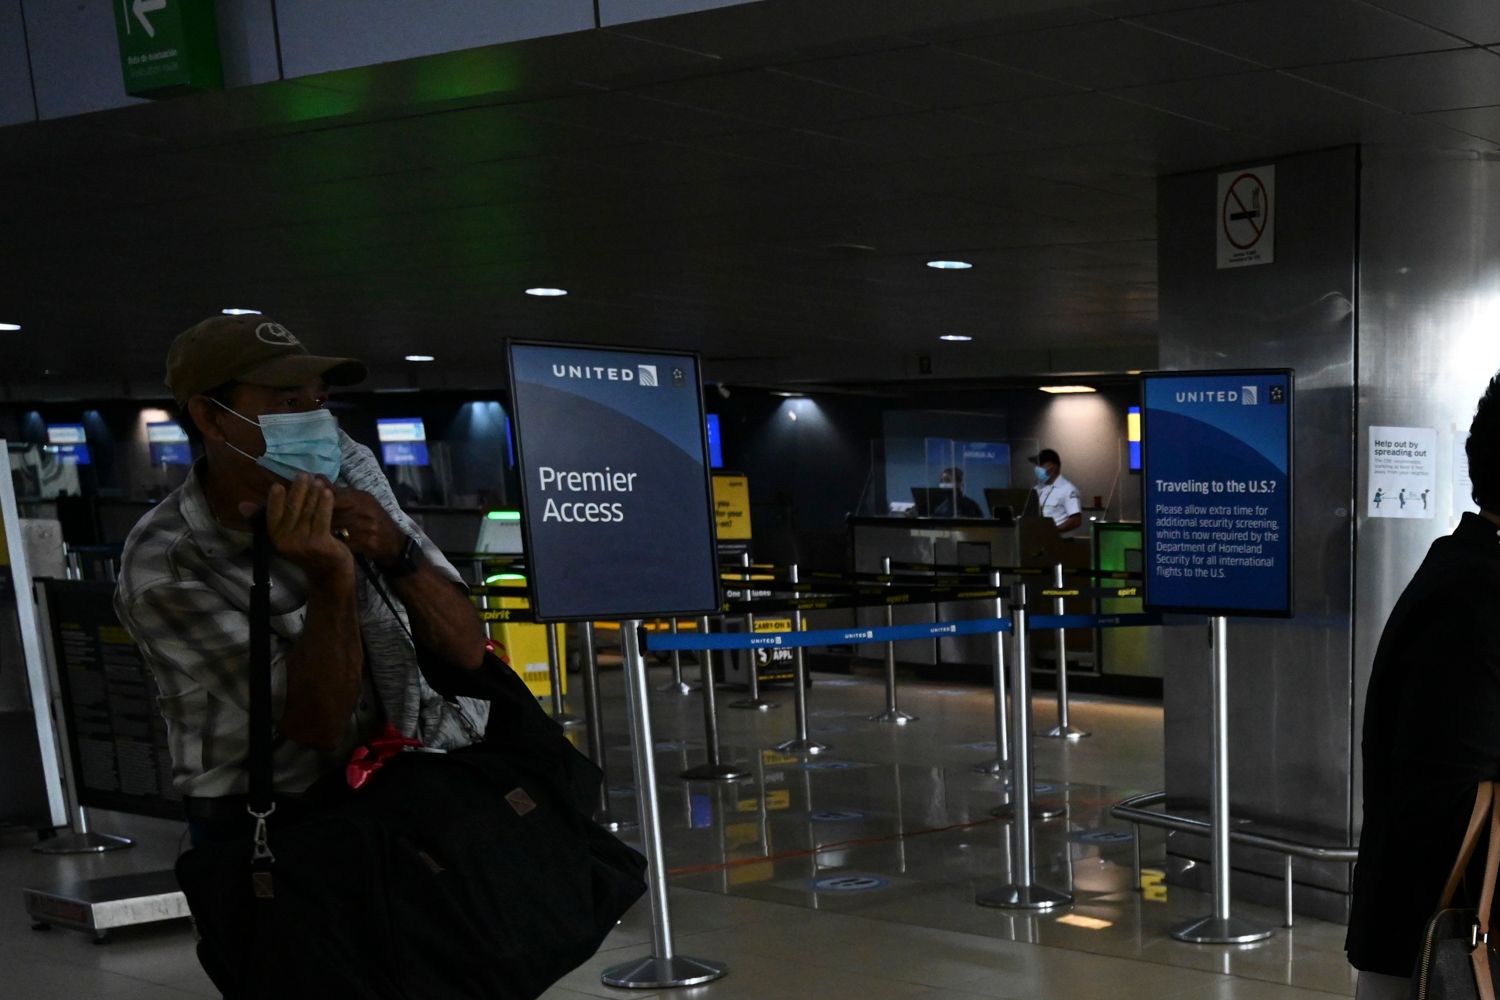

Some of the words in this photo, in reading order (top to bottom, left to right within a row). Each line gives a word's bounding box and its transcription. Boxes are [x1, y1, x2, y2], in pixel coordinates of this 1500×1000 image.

[553, 364, 634, 382] UNITED
[1176, 391, 1238, 403] UNITED
[1375, 440, 1392, 448] Help
[1409, 441, 1418, 450] by
[1374, 449, 1412, 457] spreading
[539, 467, 637, 492] Premier
[1156, 480, 1209, 494] Traveling
[1211, 481, 1224, 492] to
[1226, 480, 1246, 492] the
[1249, 480, 1276, 493] U.S.?
[543, 498, 624, 522] Access
[1156, 504, 1182, 514] Please
[1184, 505, 1207, 515] allow
[1209, 506, 1231, 515] extra
[1233, 505, 1253, 515] time
[1255, 506, 1268, 516] for
[1156, 517, 1197, 527] additional
[1199, 518, 1233, 529] security
[1235, 519, 1279, 530] screening,
[1156, 530, 1181, 539] which
[1183, 530, 1190, 540] is
[1192, 532, 1210, 540] now
[1212, 531, 1249, 542] required
[1251, 531, 1262, 543] by
[1264, 532, 1279, 541] the
[1156, 542, 1205, 552] Department
[1207, 543, 1217, 552] of
[1219, 543, 1262, 554] Homeland
[1156, 554, 1190, 566] Security
[1192, 555, 1205, 565] for
[1207, 555, 1217, 565] all
[1219, 556, 1274, 567] international
[1157, 566, 1182, 578] flights
[1184, 568, 1193, 577] to
[1195, 568, 1209, 577] the
[1211, 568, 1226, 578] U.S.
[481, 609, 511, 621] pirit
[773, 650, 792, 661] APPL
